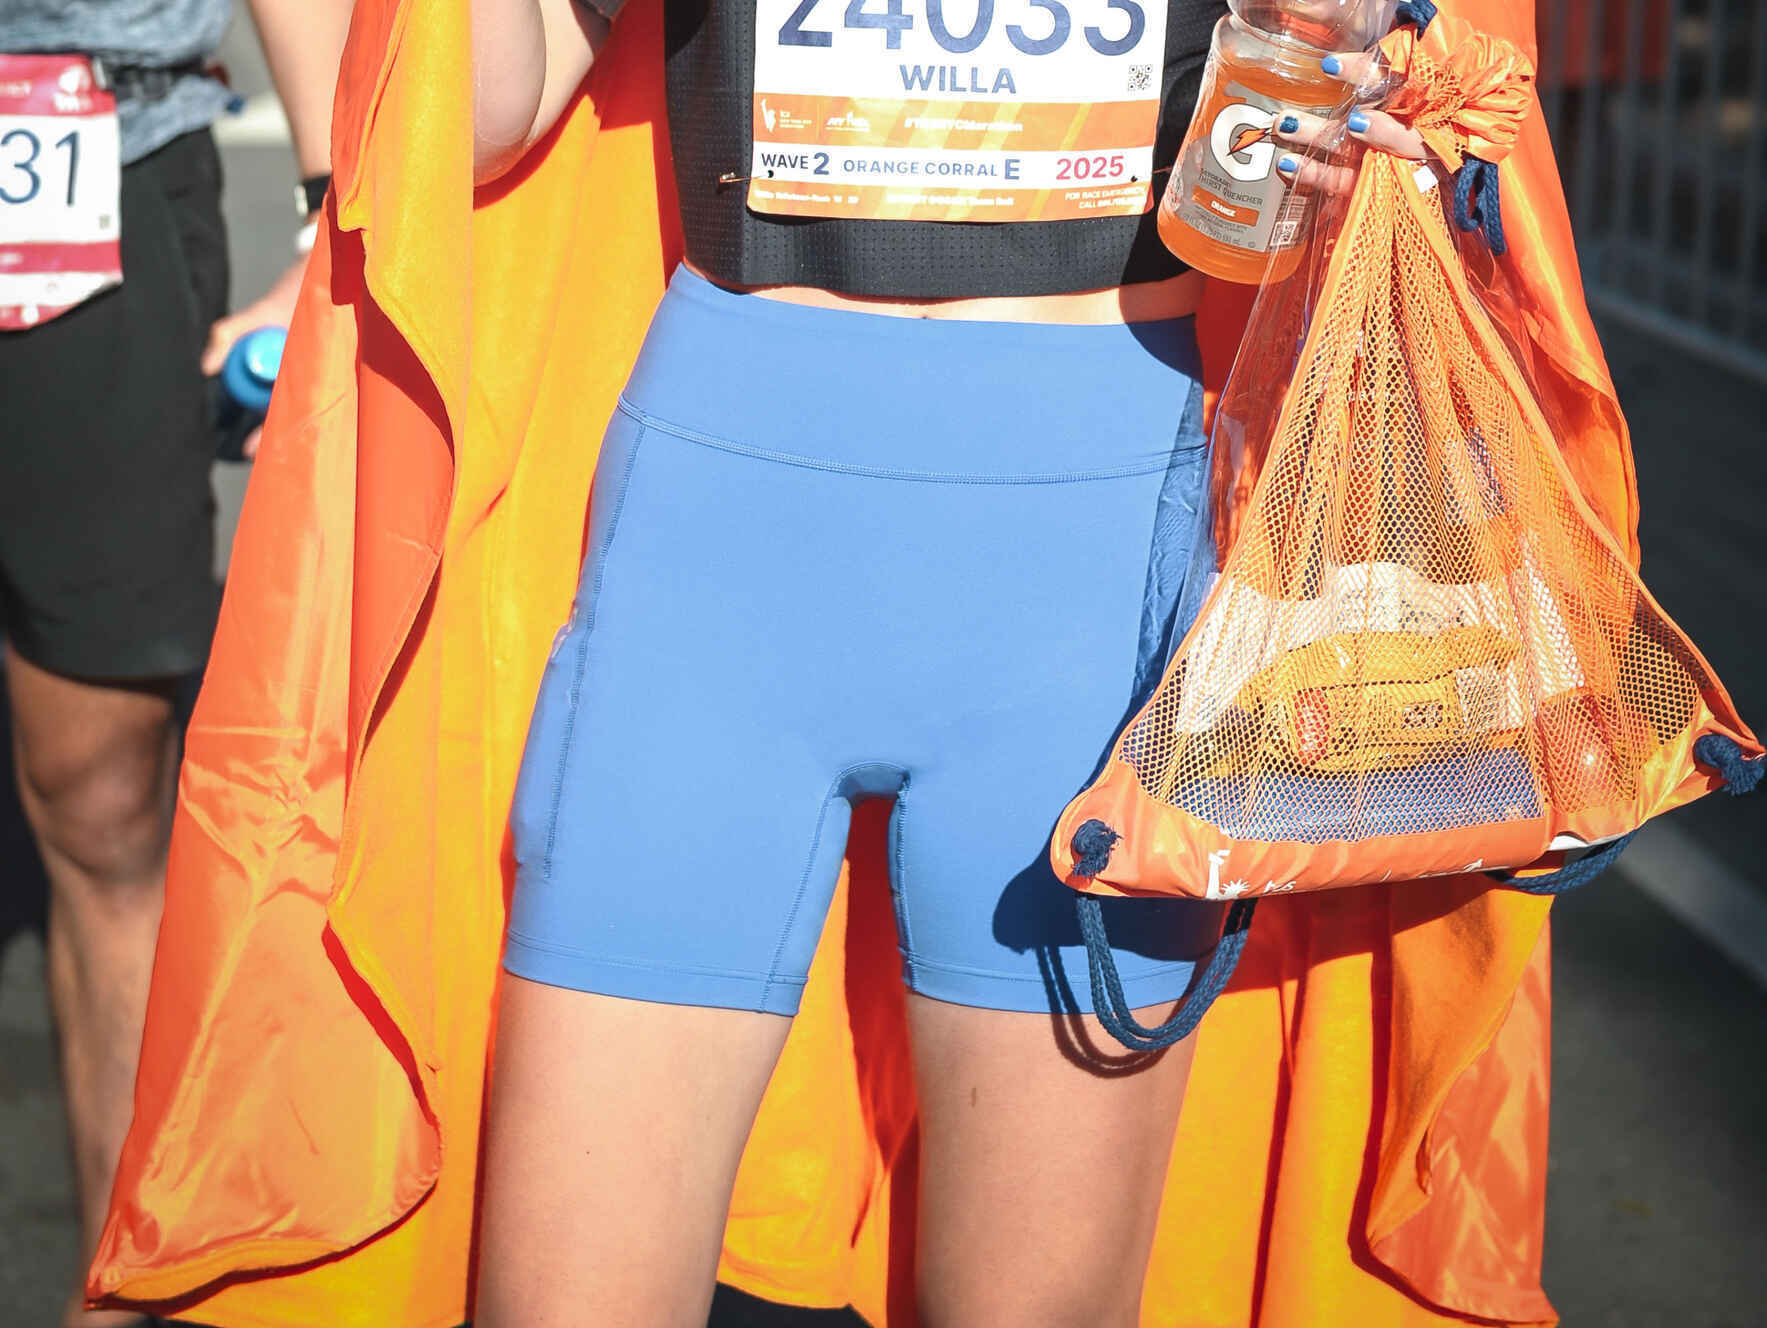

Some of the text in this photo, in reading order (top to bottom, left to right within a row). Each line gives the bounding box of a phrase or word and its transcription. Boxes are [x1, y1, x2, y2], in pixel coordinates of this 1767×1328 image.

[899, 64, 1017, 94] WILLA
[0, 128, 81, 208] 31
[760, 152, 1020, 181] WAVE 2 ORANGE CORRAL E
[1056, 155, 1125, 181] 2025
